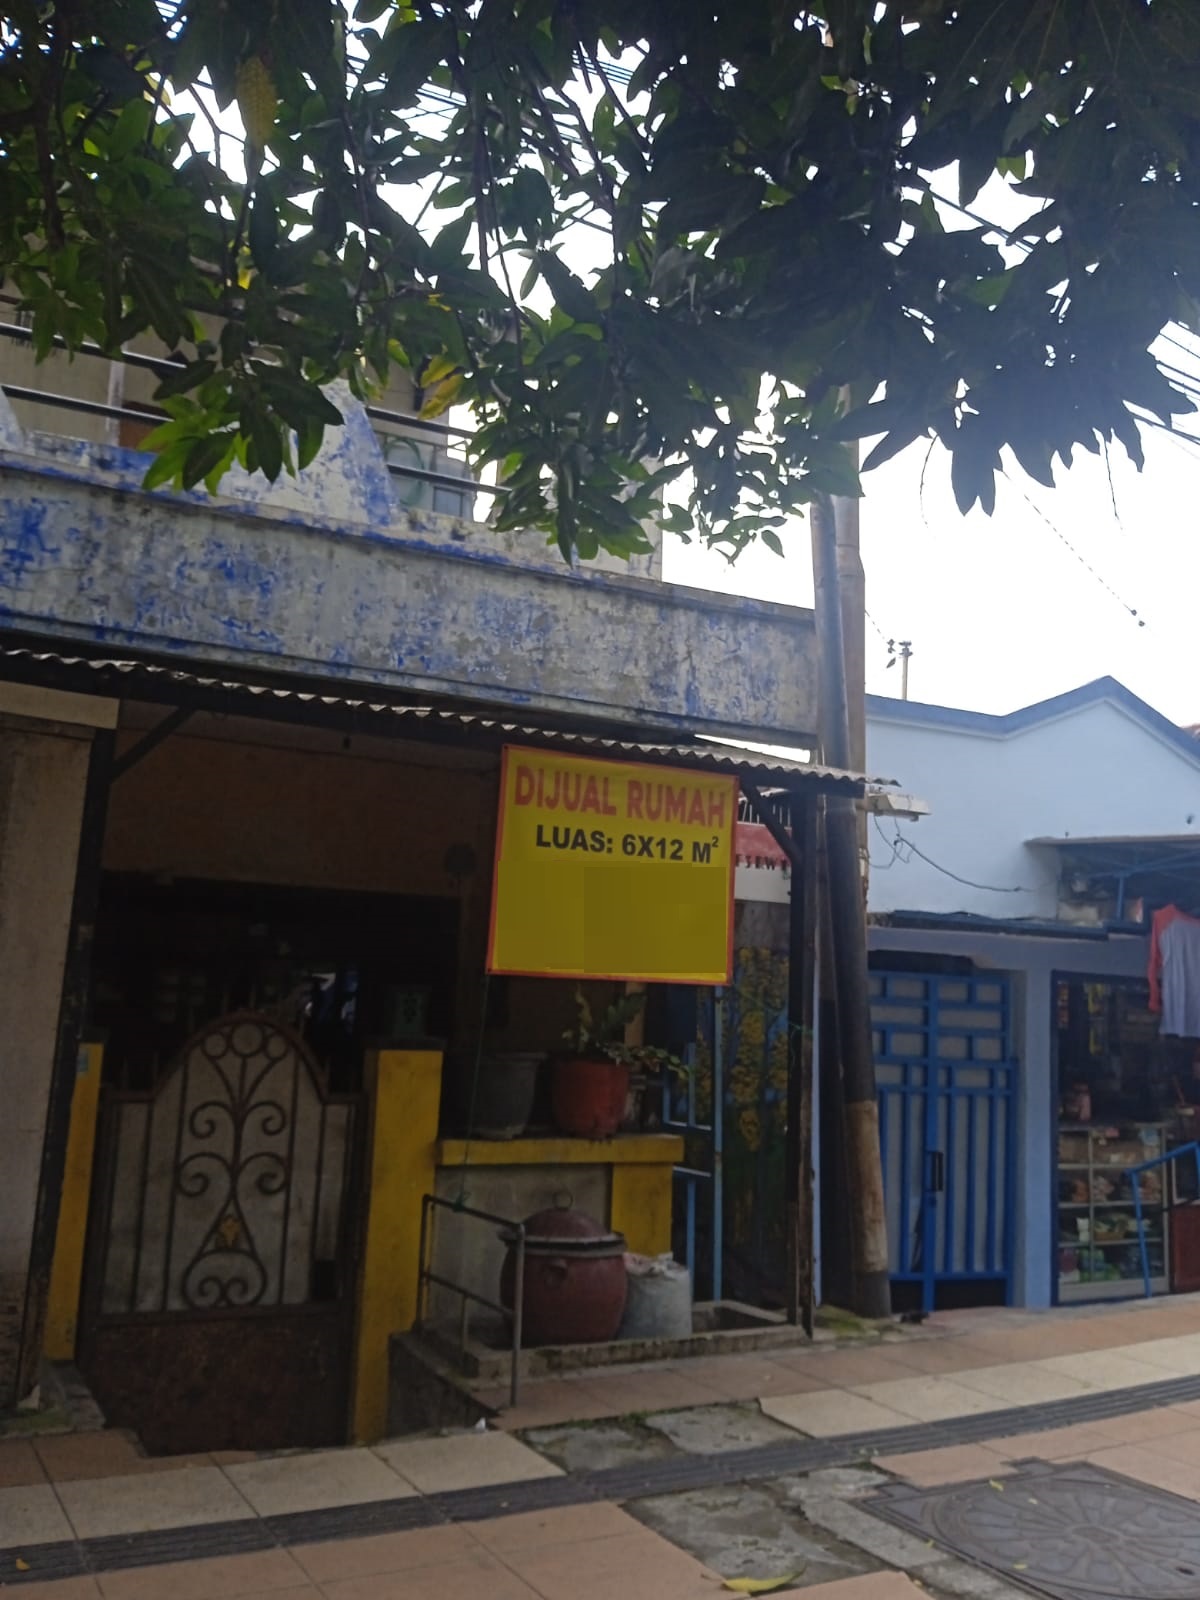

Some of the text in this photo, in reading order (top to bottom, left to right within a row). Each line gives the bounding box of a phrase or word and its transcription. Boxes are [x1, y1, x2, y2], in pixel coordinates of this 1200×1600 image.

[514, 765, 726, 829] DIJUAL RUMAH
[536, 824, 613, 854] LUAS:
[622, 833, 683, 861] 6X12
